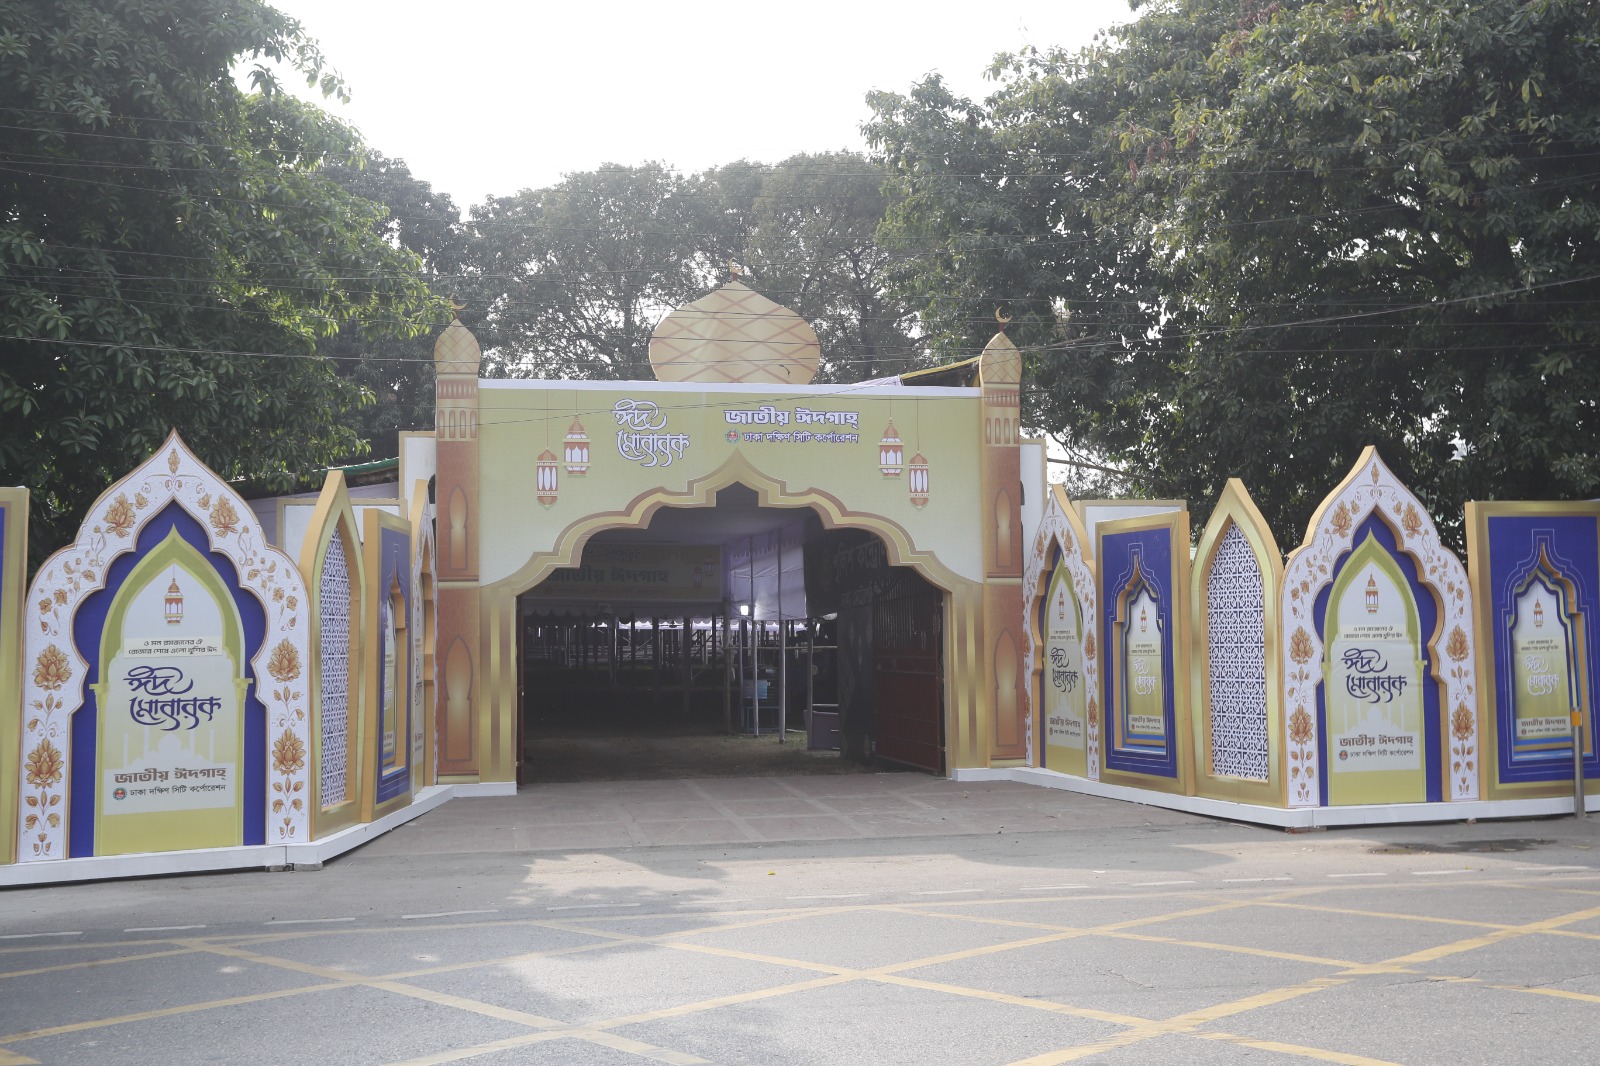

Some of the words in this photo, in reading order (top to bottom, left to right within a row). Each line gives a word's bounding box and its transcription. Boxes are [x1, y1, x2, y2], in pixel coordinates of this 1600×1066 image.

[610, 398, 667, 431] ঈদ
[724, 406, 790, 426] জাতীয়
[743, 431, 764, 443] ঢাকা
[765, 430, 791, 443] দক্ষিণ
[792, 431, 812, 443] সিটি
[813, 430, 859, 443] কর্পোরেশন
[616, 429, 690, 467] মোবারক
[1050, 647, 1070, 668] ঈদ
[1340, 648, 1388, 673] ঈদ
[1524, 655, 1549, 673] ঈদ
[123, 665, 194, 696] ঈদ
[1052, 668, 1079, 693] মোবারক
[1346, 674, 1407, 704] মোবারক
[1527, 673, 1559, 695] মোবারক
[129, 696, 222, 731] মোবারক
[1339, 734, 1375, 747] জাতীয়
[114, 767, 169, 783] জাতীয়
[130, 788, 146, 796] ঢাকা
[149, 786, 170, 795] দক্ষিণ
[171, 785, 188, 794] সিটি
[189, 783, 226, 793] কর্পোরেশন
